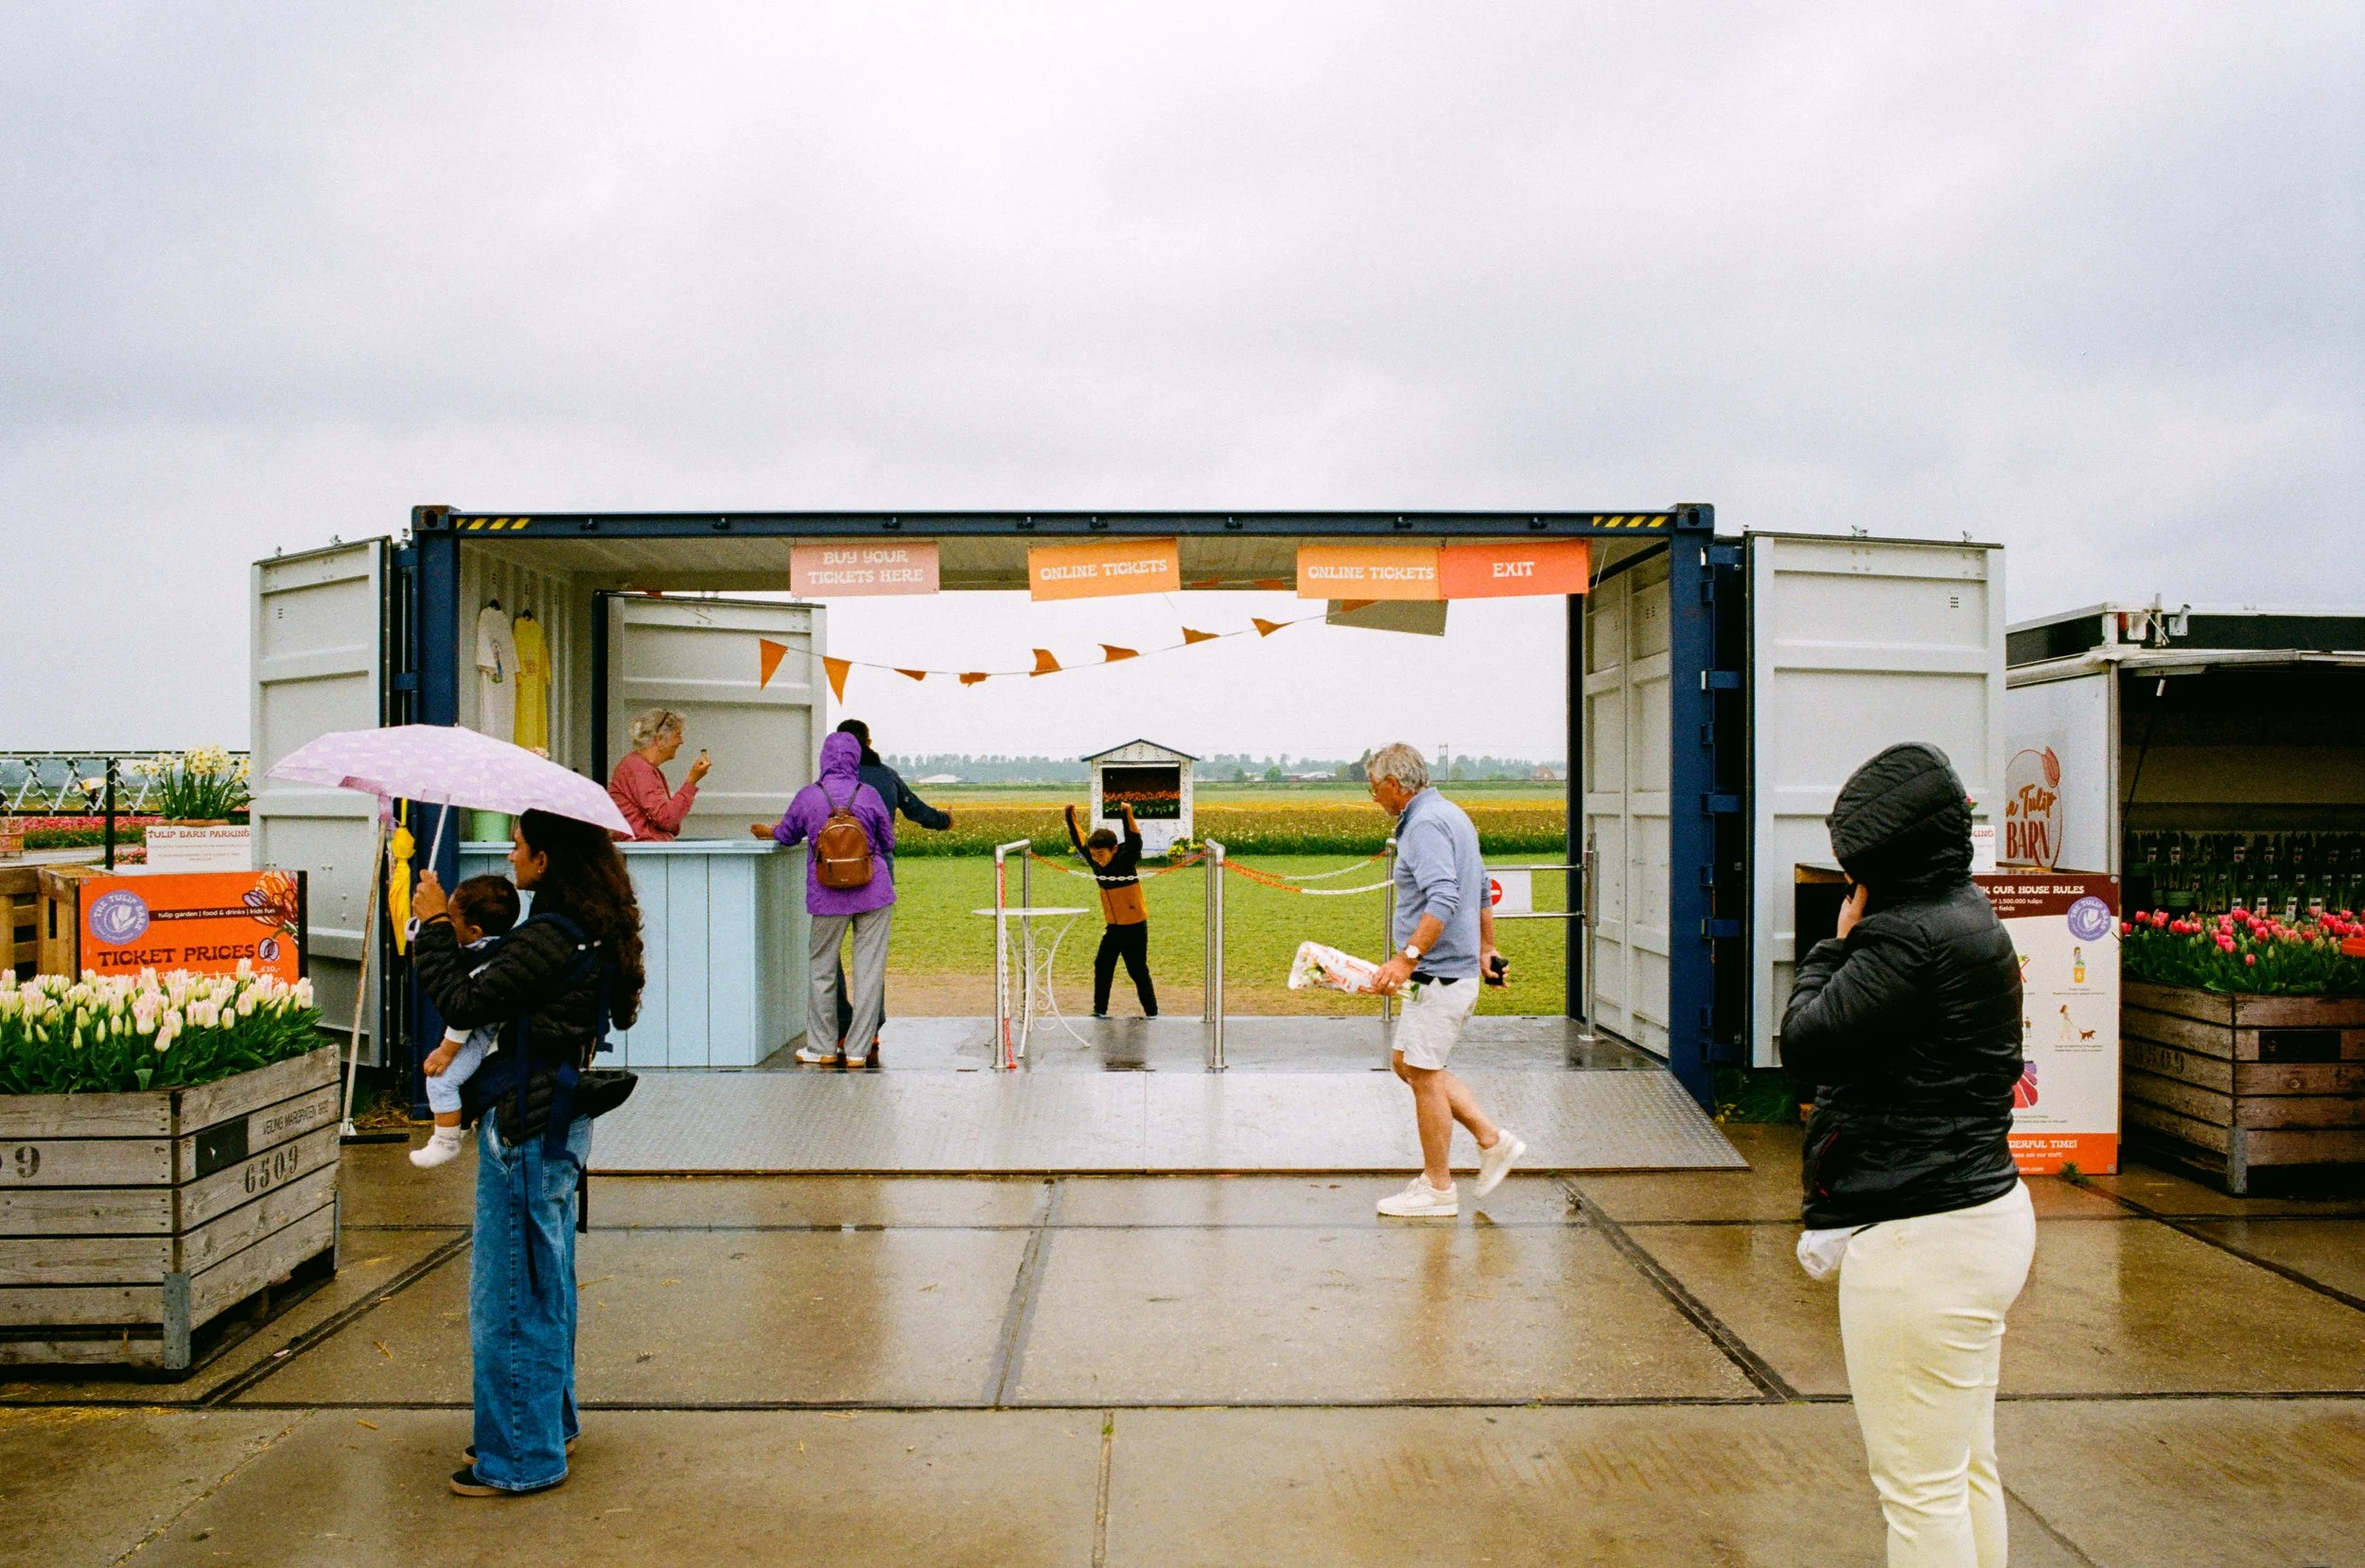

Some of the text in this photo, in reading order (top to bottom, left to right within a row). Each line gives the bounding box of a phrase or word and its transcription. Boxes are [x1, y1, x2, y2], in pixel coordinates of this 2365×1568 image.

[823, 549, 909, 566] BUY YOUR
[808, 568, 924, 585] TICKETS HERE
[1040, 559, 1167, 581] ONLINE TICKETS
[1307, 566, 1435, 581] ONLINE TICKETS
[1492, 561, 1535, 578] EXIT
[2019, 784, 2057, 819] Tulip
[148, 828, 251, 839] TULIP BARN PARKING
[2006, 821, 2050, 867] BARN
[1992, 885, 2016, 895] OUR
[2018, 885, 2050, 895] HOUSE
[2053, 885, 2085, 895] RULES
[93, 894, 146, 931] THE TULIP BARN
[97, 944, 255, 967] TICKET PRICES
[2008, 1140, 2048, 1149] DERFUL
[245, 1145, 299, 1193] 6509
